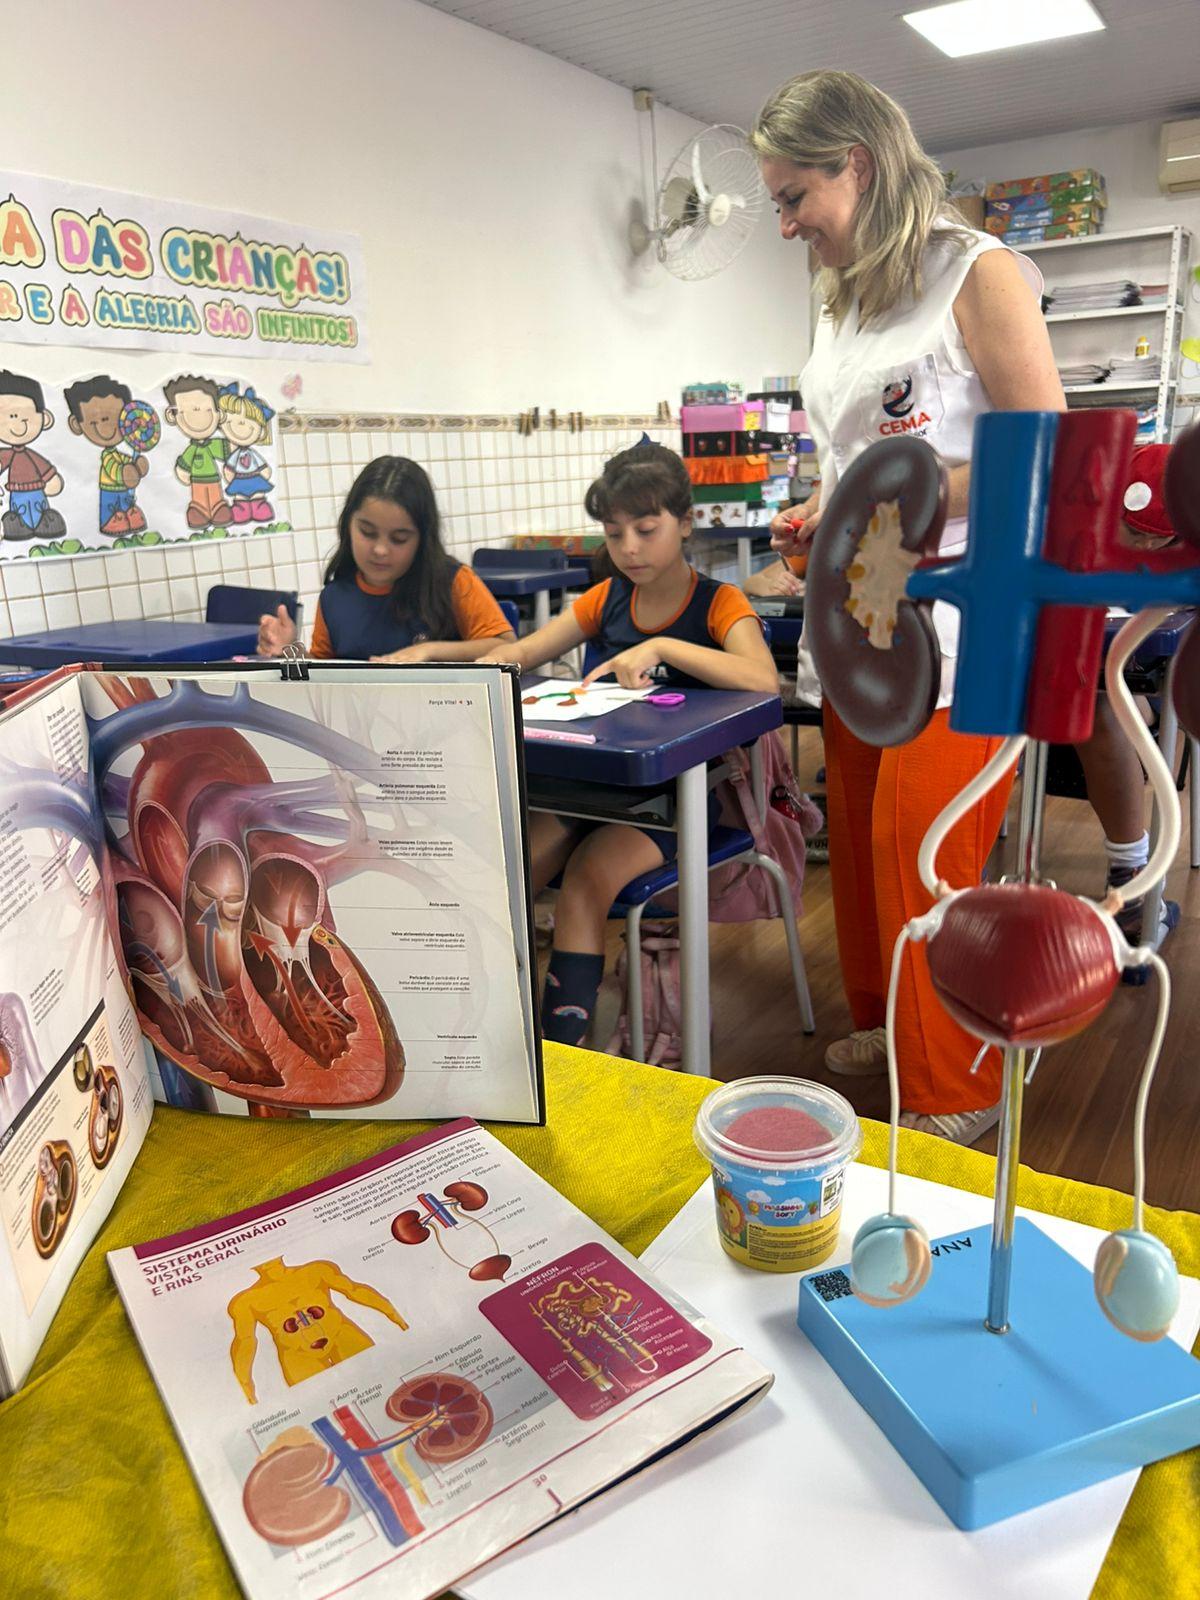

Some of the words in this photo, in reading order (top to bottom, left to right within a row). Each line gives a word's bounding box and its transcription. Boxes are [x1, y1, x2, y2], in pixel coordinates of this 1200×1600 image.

[58, 217, 148, 273] DAS
[166, 235, 346, 301] CRIANÇAS!
[28, 289, 50, 319] E
[64, 292, 86, 322] A
[98, 295, 198, 330] ALEGRIA
[205, 302, 250, 335] SÃO
[259, 311, 357, 344] INFINITOS!
[878, 411, 932, 436] CEMA
[314, 1206, 342, 1219] sangue,
[342, 1198, 359, 1207] bem
[359, 1189, 378, 1200] como
[378, 1184, 390, 1192] por
[390, 1170, 414, 1185] regular
[420, 1152, 455, 1171] quantidade
[465, 1141, 480, 1153] água
[323, 1201, 337, 1209] rins
[360, 1180, 383, 1193] órgãos
[384, 1159, 426, 1181] responsáveis
[426, 1154, 437, 1162] por
[437, 1144, 456, 1156] filtrar
[457, 1137, 476, 1147] nosso
[342, 1206, 372, 1221] também
[373, 1194, 398, 1209] ajudam
[403, 1179, 427, 1193] regular
[433, 1164, 459, 1179] pressão
[343, 1199, 372, 1214] minerais
[373, 1182, 406, 1202] presentes
[417, 1168, 436, 1180] nosso
[142, 1248, 213, 1275] SISTEMA
[215, 1218, 287, 1250] URINÁRIO
[362, 1248, 384, 1261] Direito
[146, 1265, 193, 1284] VISTA
[195, 1247, 245, 1269] GERAL
[520, 1259, 542, 1272] Uretra
[152, 1286, 162, 1296] E
[165, 1272, 203, 1292] RINS
[526, 1266, 559, 1286] NÉFRON
[434, 1352, 450, 1362] Rim
[450, 1334, 482, 1354] Esquerdo
[454, 1347, 482, 1366] Cápsula
[485, 1355, 516, 1376] Pirâmide
[501, 1367, 523, 1382] Pélvis
[336, 1386, 359, 1401] Aorta
[356, 1383, 383, 1399] Artéria
[360, 1391, 383, 1405] Renal
[520, 1390, 549, 1410] Medula
[252, 1409, 287, 1429] Glândula
[254, 1408, 301, 1435] Suprarrenal
[501, 1423, 528, 1441] Artéria
[505, 1420, 546, 1448] Segmental
[464, 1457, 488, 1475] Renal
[446, 1480, 472, 1500] Ureter
[532, 1474, 548, 1488] 30
